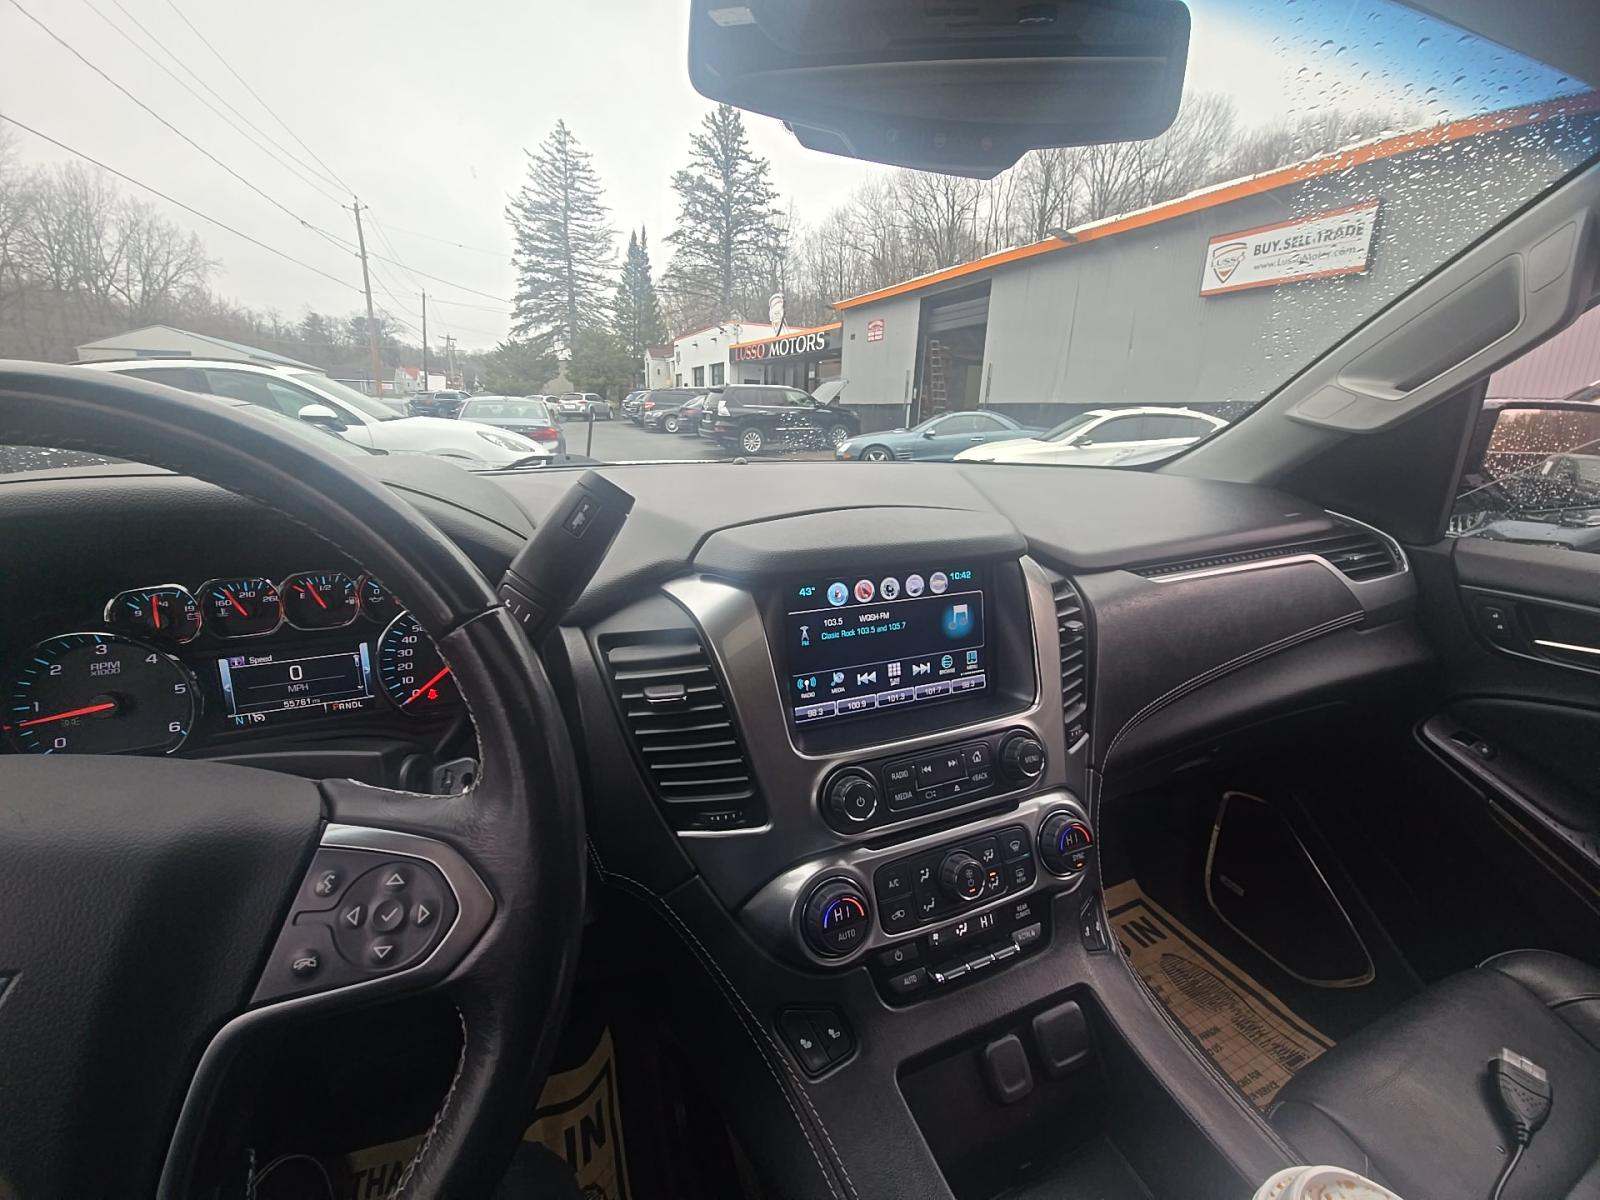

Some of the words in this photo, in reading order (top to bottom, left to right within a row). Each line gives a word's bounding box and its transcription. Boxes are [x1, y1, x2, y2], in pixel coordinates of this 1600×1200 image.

[735, 343, 765, 361] LUSSO
[769, 331, 825, 357] MOTORS
[950, 571, 971, 581] 10:42
[238, 591, 256, 599] 210
[823, 617, 843, 627] 103.5
[841, 628, 856, 637] Rock
[857, 626, 876, 635] 103.5
[876, 624, 887, 633] and
[95, 644, 108, 655] 3
[397, 649, 413, 657] 30
[145, 653, 158, 664] 4
[249, 654, 273, 665] Speed
[50, 664, 62, 676] 2
[90, 660, 121, 670] RPM
[397, 663, 413, 671] 20
[289, 665, 303, 681] 0
[402, 676, 414, 684] 10
[174, 683, 186, 694] 5
[287, 683, 309, 693] MPH
[33, 701, 39, 712] 1
[235, 716, 244, 725] N
[168, 721, 181, 732] 6
[54, 737, 67, 749] 0
[891, 769, 909, 781] RADIO
[894, 790, 913, 801] MEDIA
[888, 878, 900, 889] A/C
[833, 905, 850, 922] HI
[838, 928, 856, 941] AUTO
[903, 974, 918, 985] AUTO
